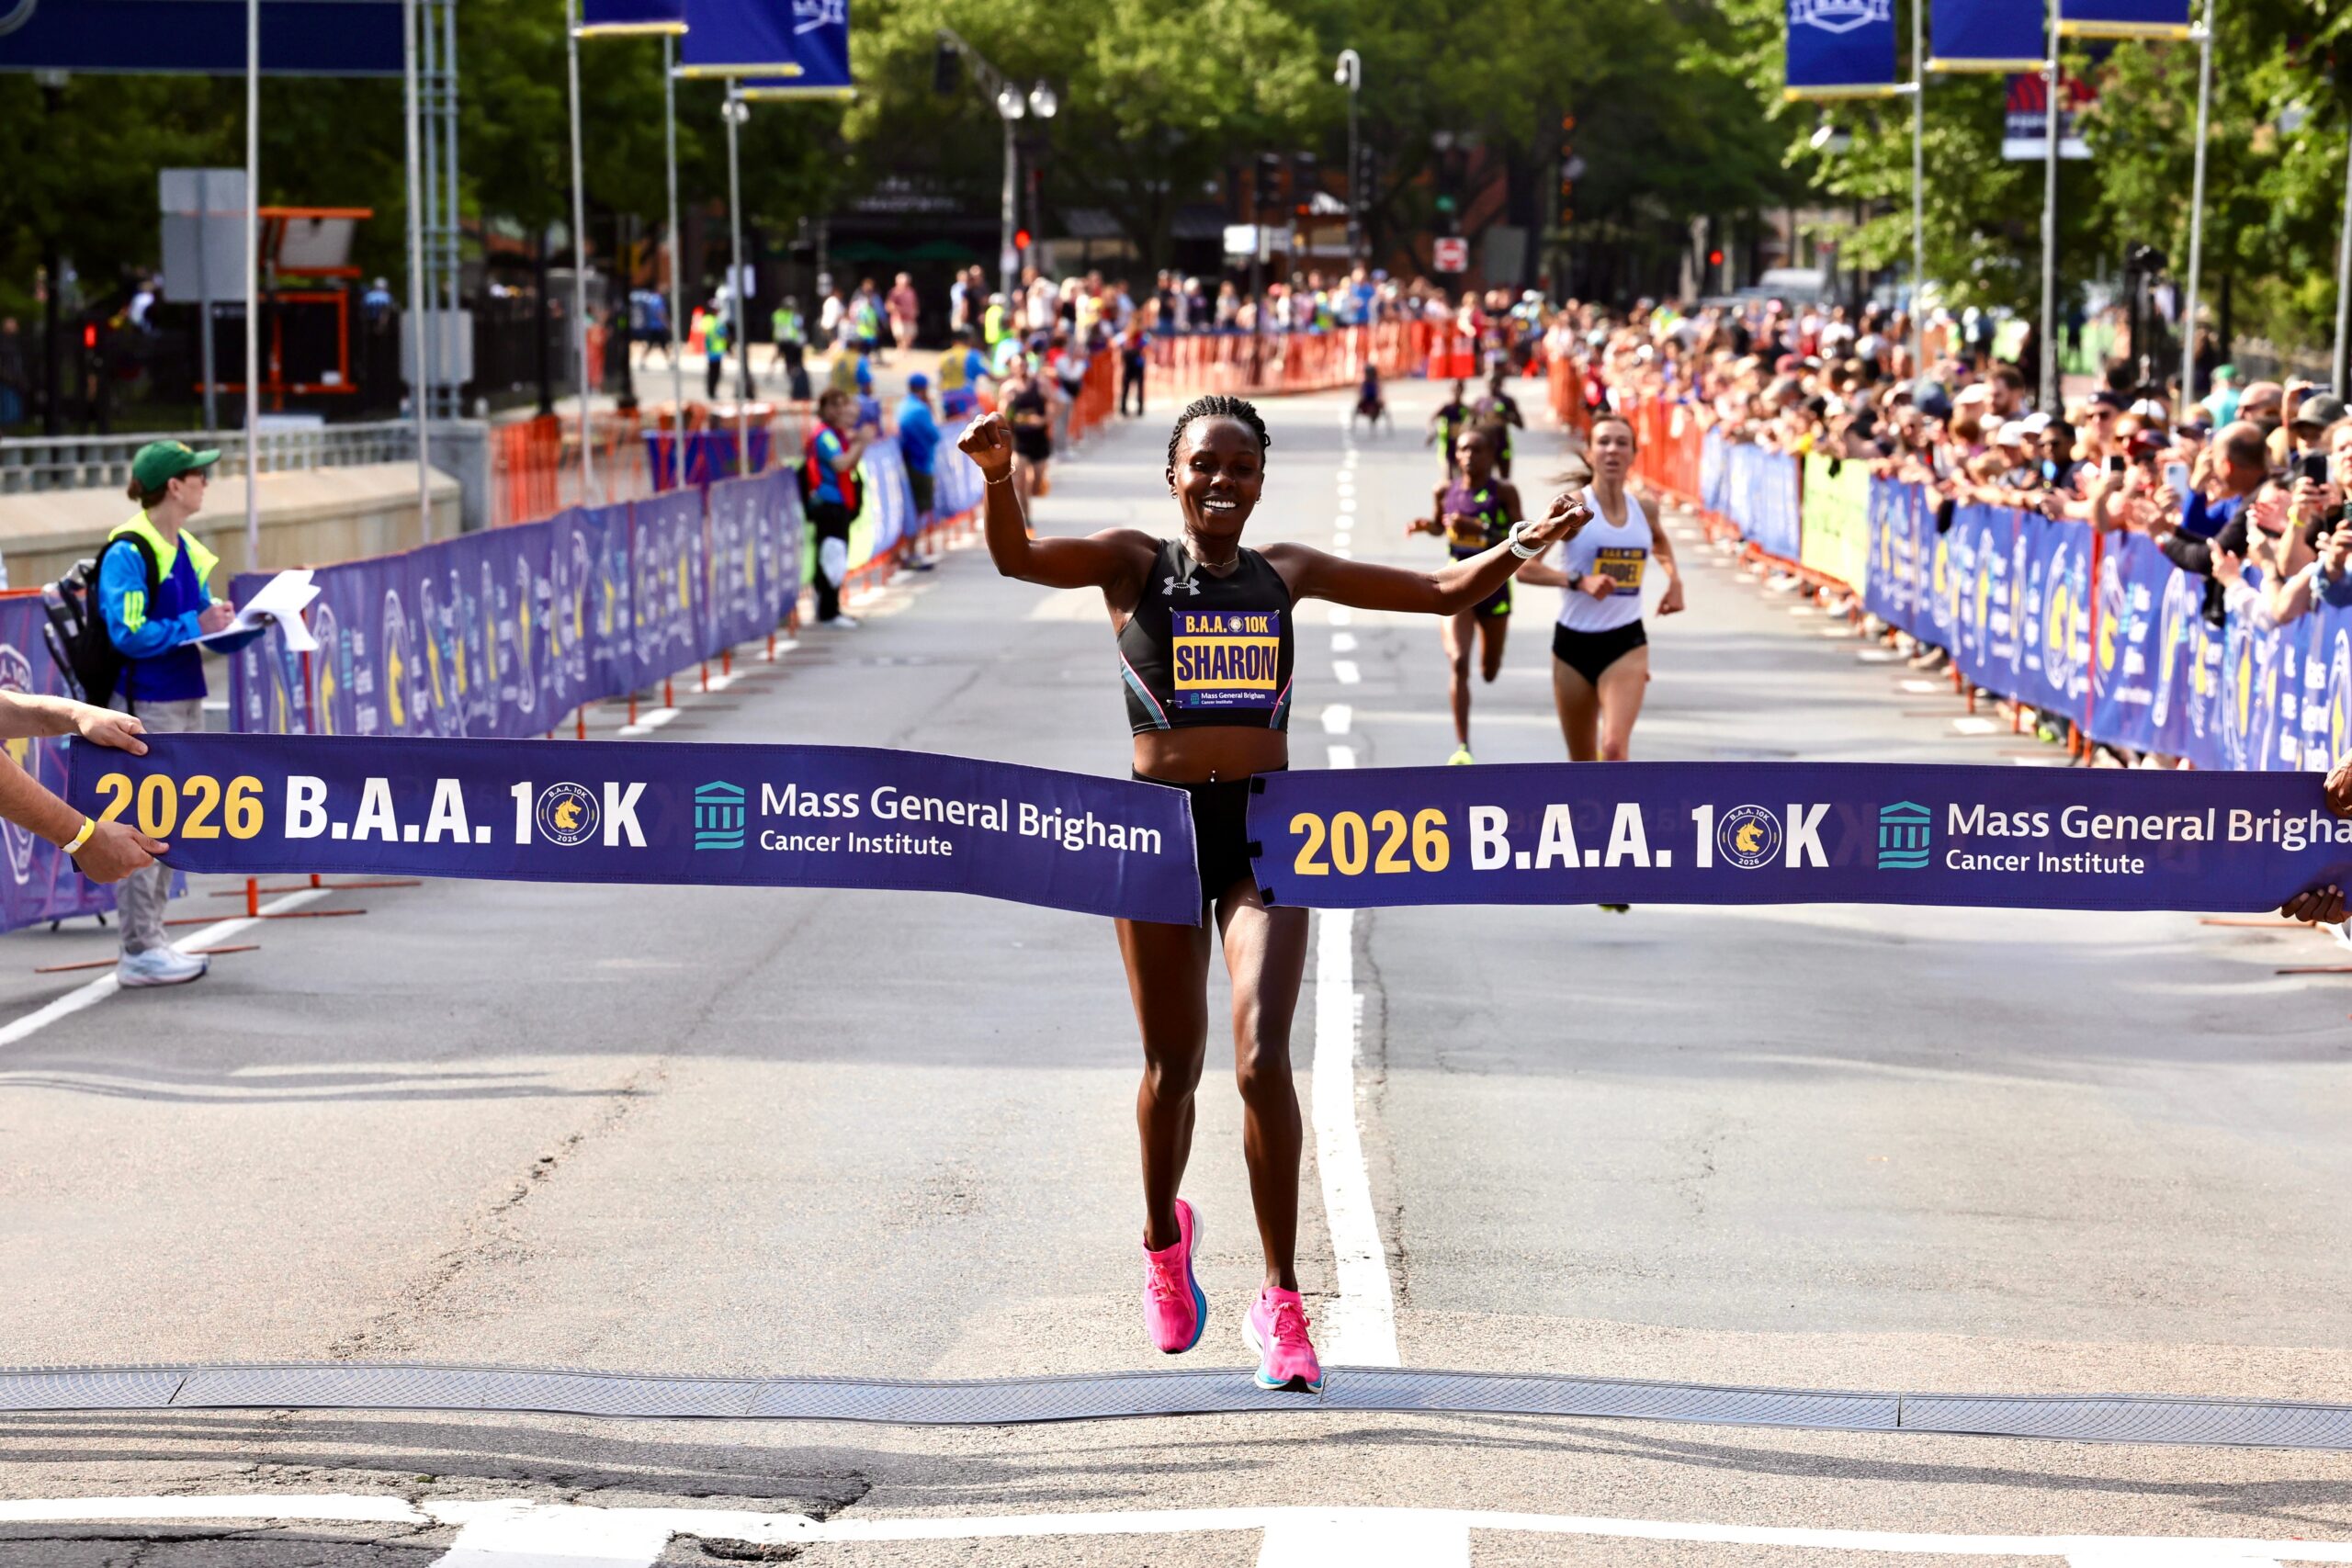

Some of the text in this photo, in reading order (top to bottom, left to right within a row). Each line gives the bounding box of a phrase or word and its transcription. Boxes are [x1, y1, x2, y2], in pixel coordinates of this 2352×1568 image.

[1185, 615, 1269, 633] B.A.A. 10K
[1176, 645, 1276, 682] SHARON
[1243, 692, 1266, 700] Brigham
[548, 785, 588, 798] B.A.A. 10K
[96, 773, 264, 840] 2026
[285, 775, 492, 844] B.A.A.
[761, 783, 1161, 854] Mass General Brigham
[1729, 808, 1770, 821] B.A.A. 10K
[1948, 803, 2049, 838] Mass
[2060, 806, 2215, 841] General
[760, 829, 953, 856] Cancer Institute
[1289, 808, 1450, 876] 2026
[1469, 802, 1672, 871] B.A.A.
[1945, 849, 2145, 874] Cancer Institute
